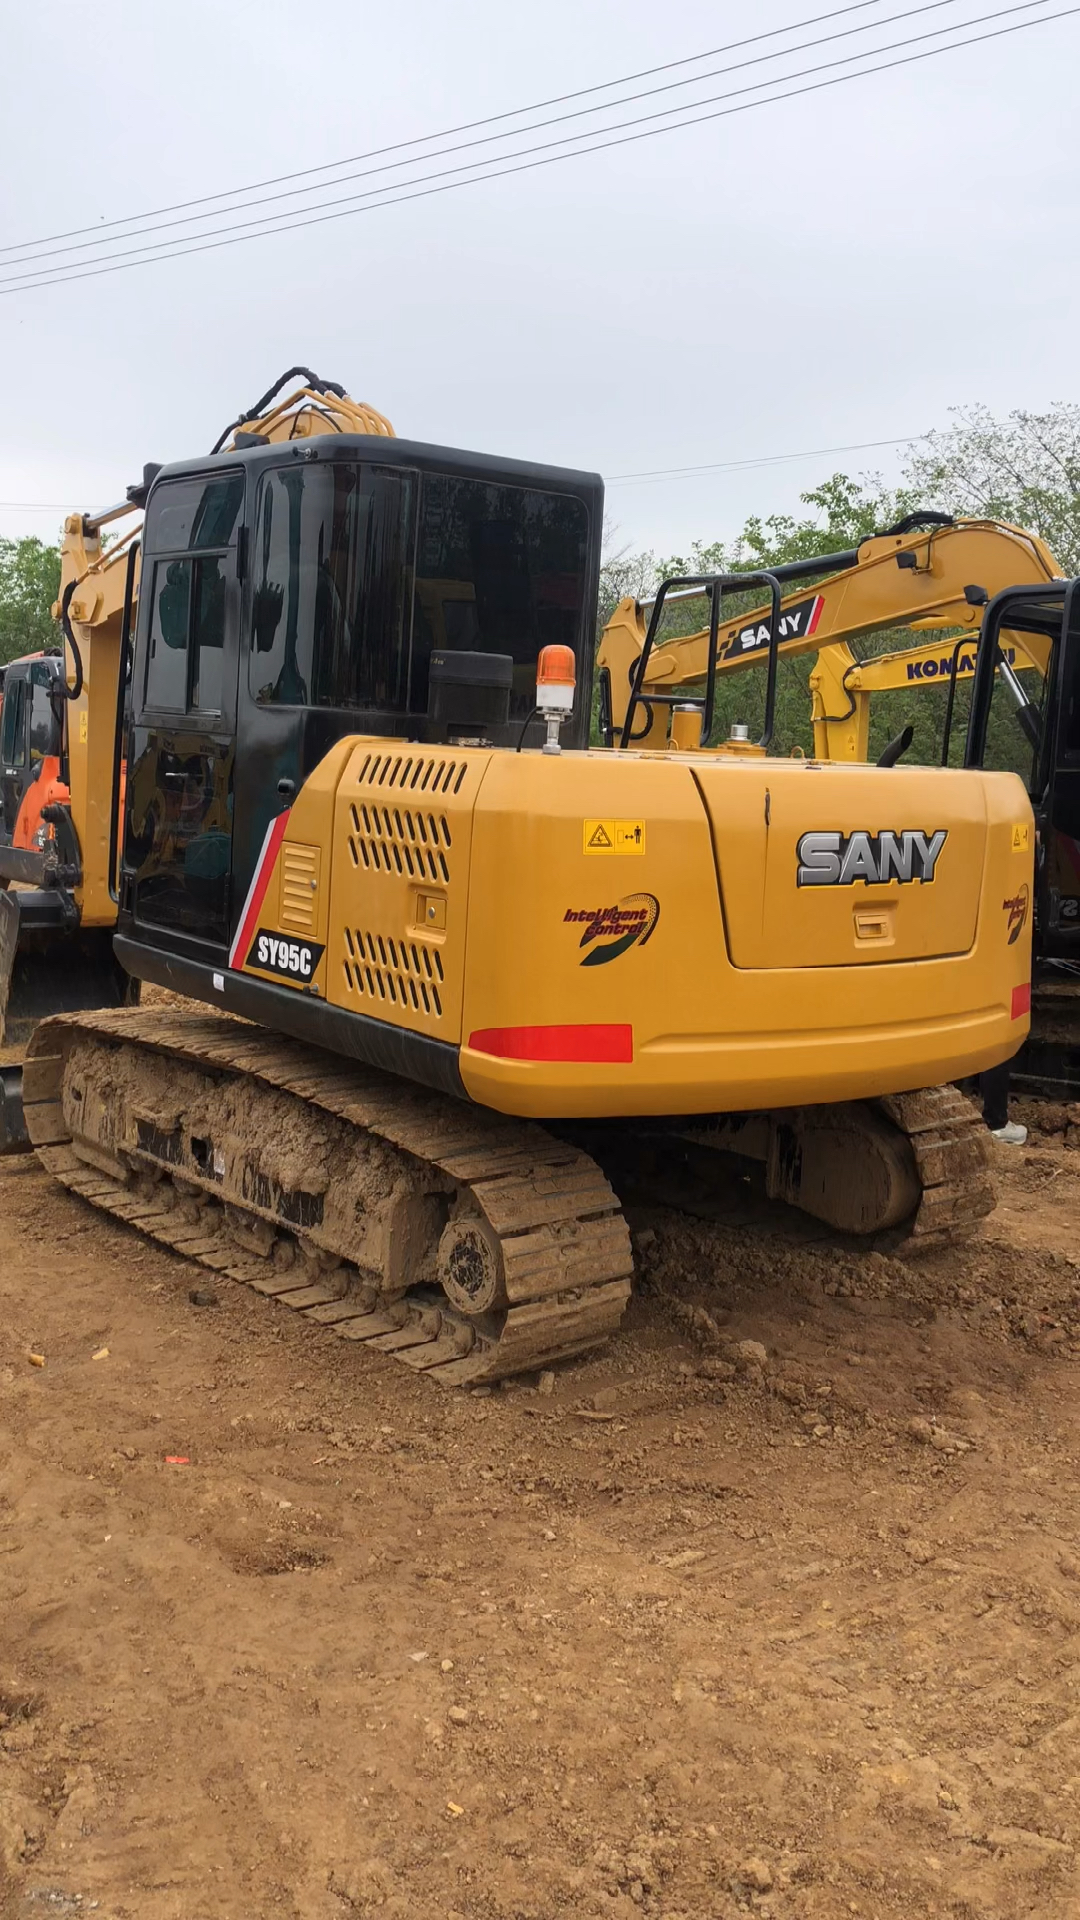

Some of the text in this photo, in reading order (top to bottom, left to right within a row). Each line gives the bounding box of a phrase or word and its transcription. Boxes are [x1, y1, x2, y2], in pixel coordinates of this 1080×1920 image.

[906, 647, 1016, 680] KOMAU
[796, 829, 949, 888] SANY
[562, 907, 650, 924] Intelligent
[257, 935, 312, 976] SY95C
